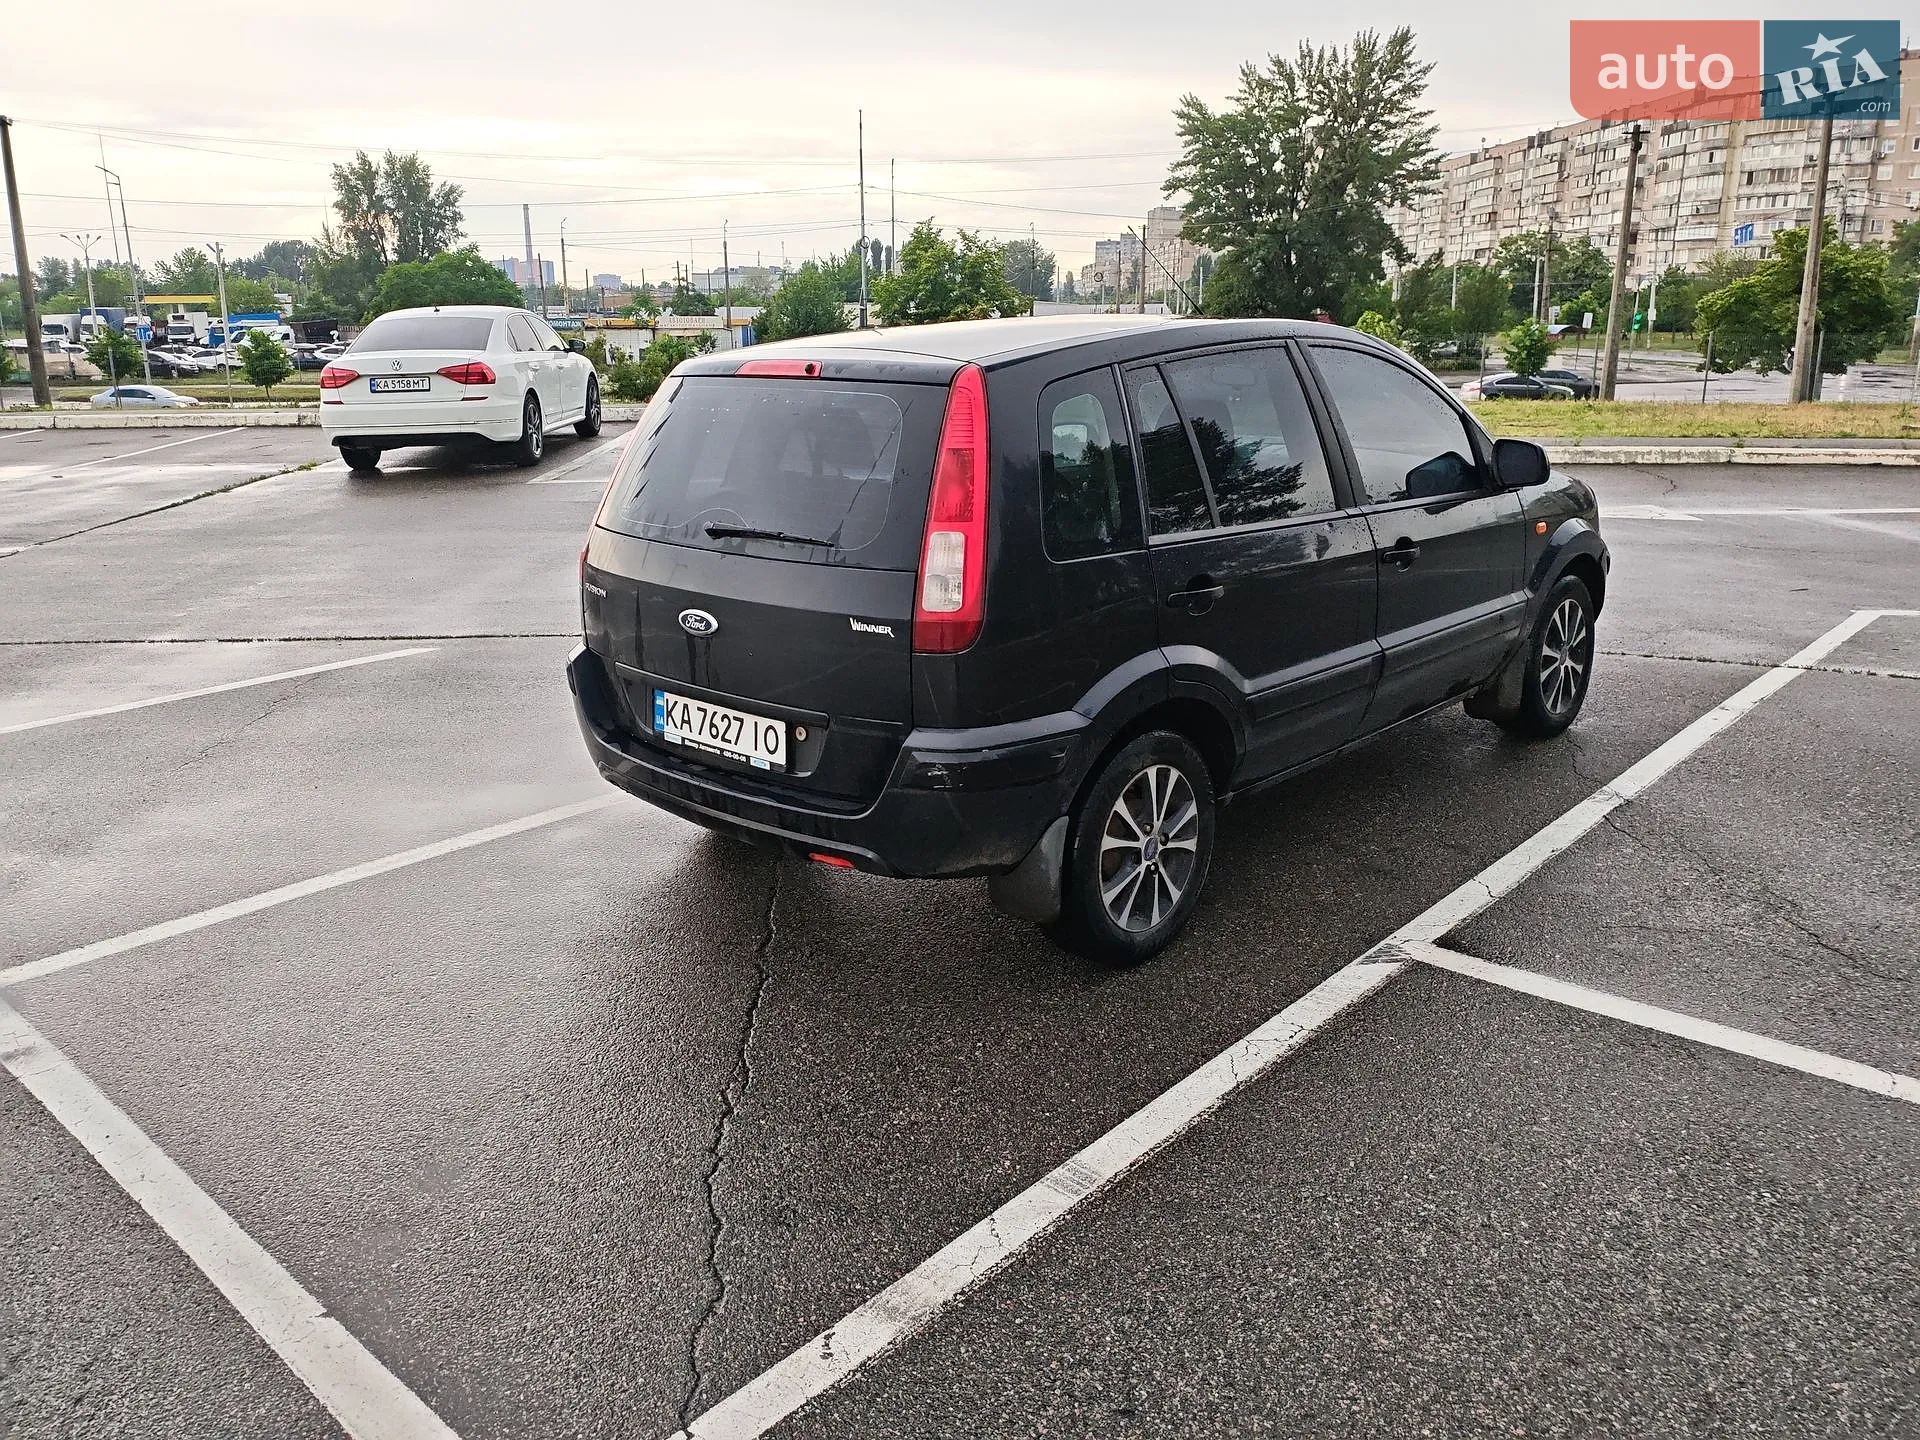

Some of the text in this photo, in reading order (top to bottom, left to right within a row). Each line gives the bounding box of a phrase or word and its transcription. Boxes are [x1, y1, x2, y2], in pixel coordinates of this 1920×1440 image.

[376, 379, 426, 390] KA 5158 MT
[685, 614, 706, 631] Ford
[666, 698, 693, 733] KA
[696, 706, 744, 746] 7627
[754, 721, 779, 755] IO
